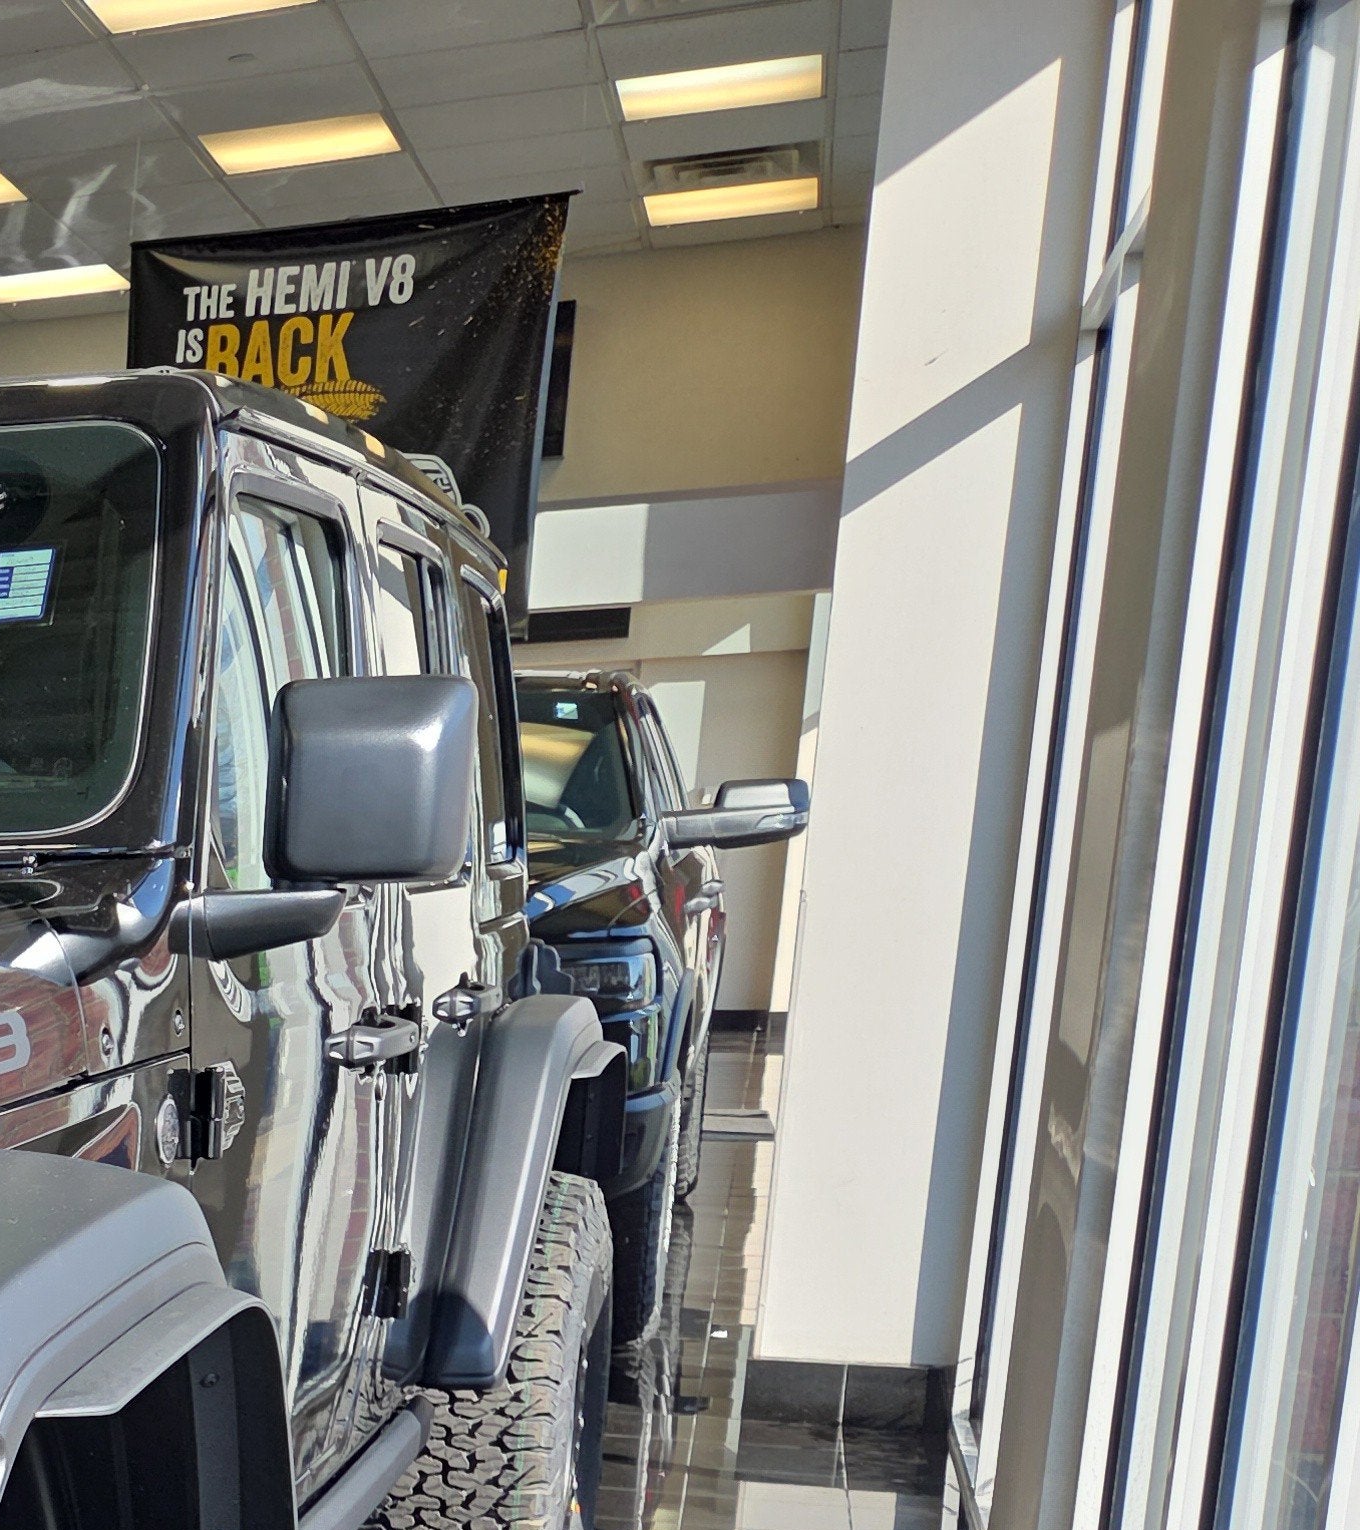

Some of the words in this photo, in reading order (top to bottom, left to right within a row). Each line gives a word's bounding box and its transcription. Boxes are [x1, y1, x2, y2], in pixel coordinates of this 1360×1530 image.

[183, 283, 238, 321] THE
[245, 260, 352, 317] HEMI
[365, 253, 416, 307] V8
[175, 327, 204, 364] IS
[205, 311, 355, 388] BACK
